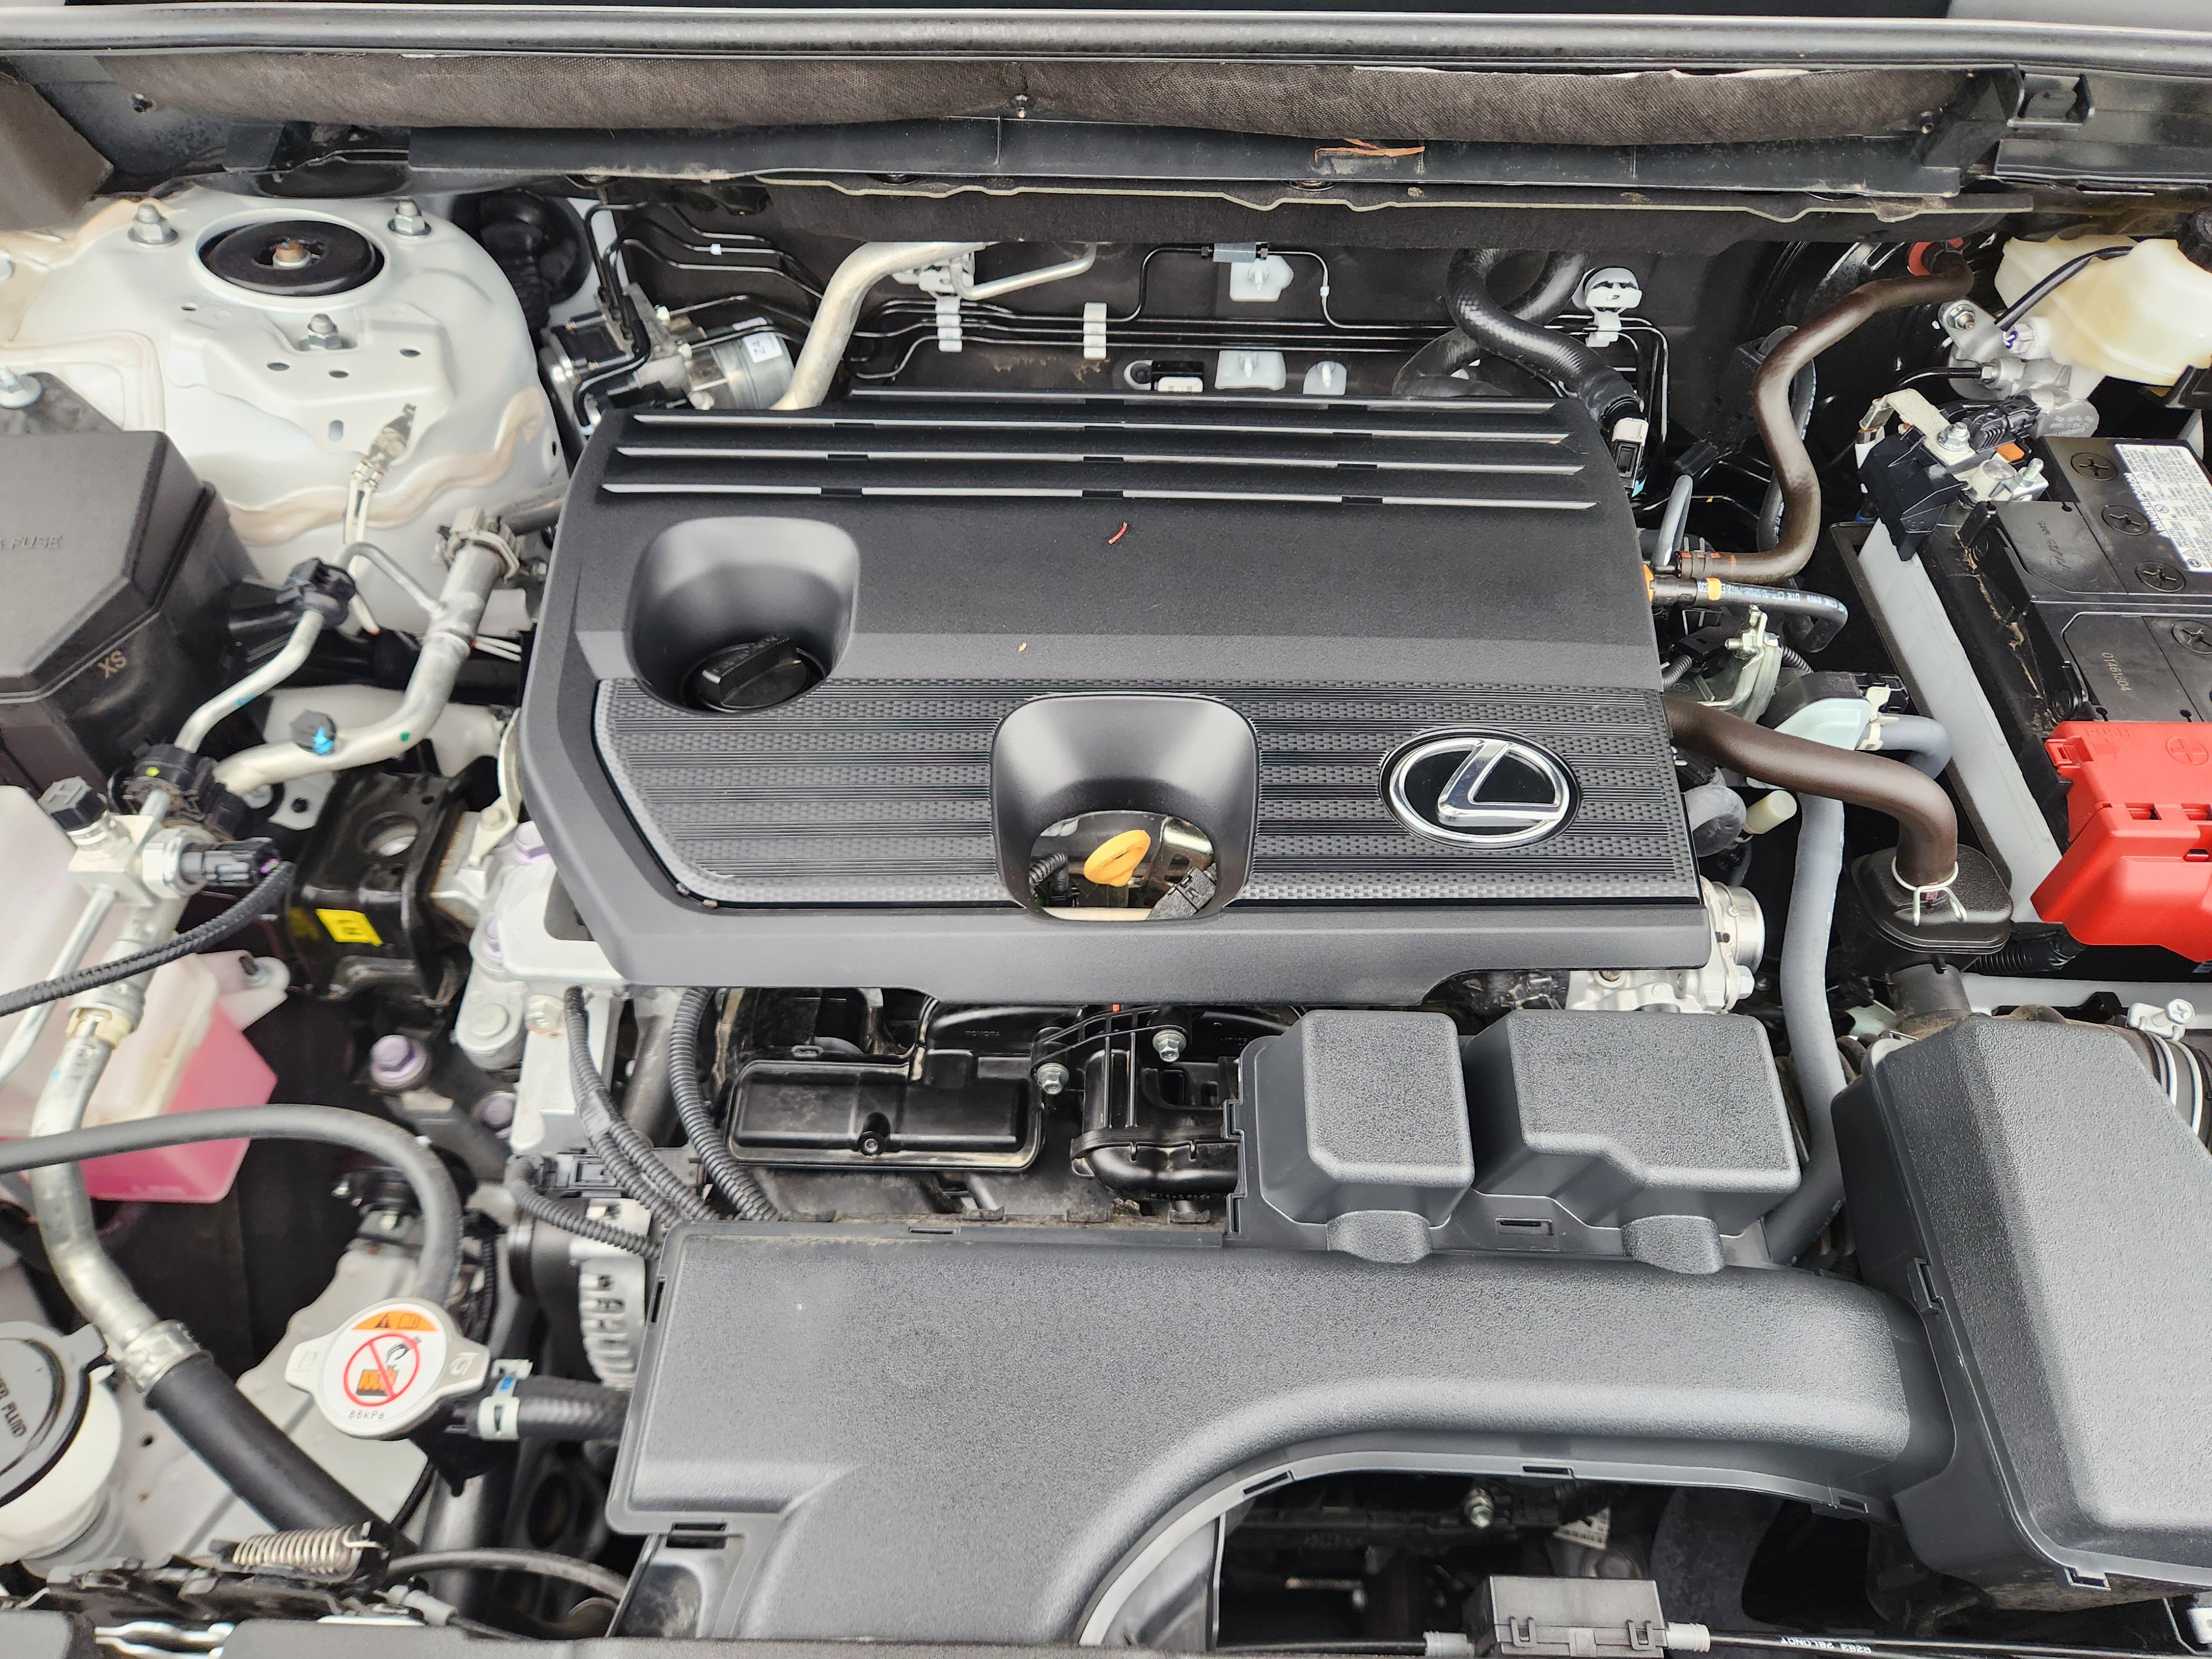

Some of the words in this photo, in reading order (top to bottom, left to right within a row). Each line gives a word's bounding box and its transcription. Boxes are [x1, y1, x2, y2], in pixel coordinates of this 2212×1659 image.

[12, 534, 63, 550] FUSE
[97, 650, 127, 679] XS
[2101, 653, 2132, 691] 01461804
[2084, 727, 2130, 738] PUSH
